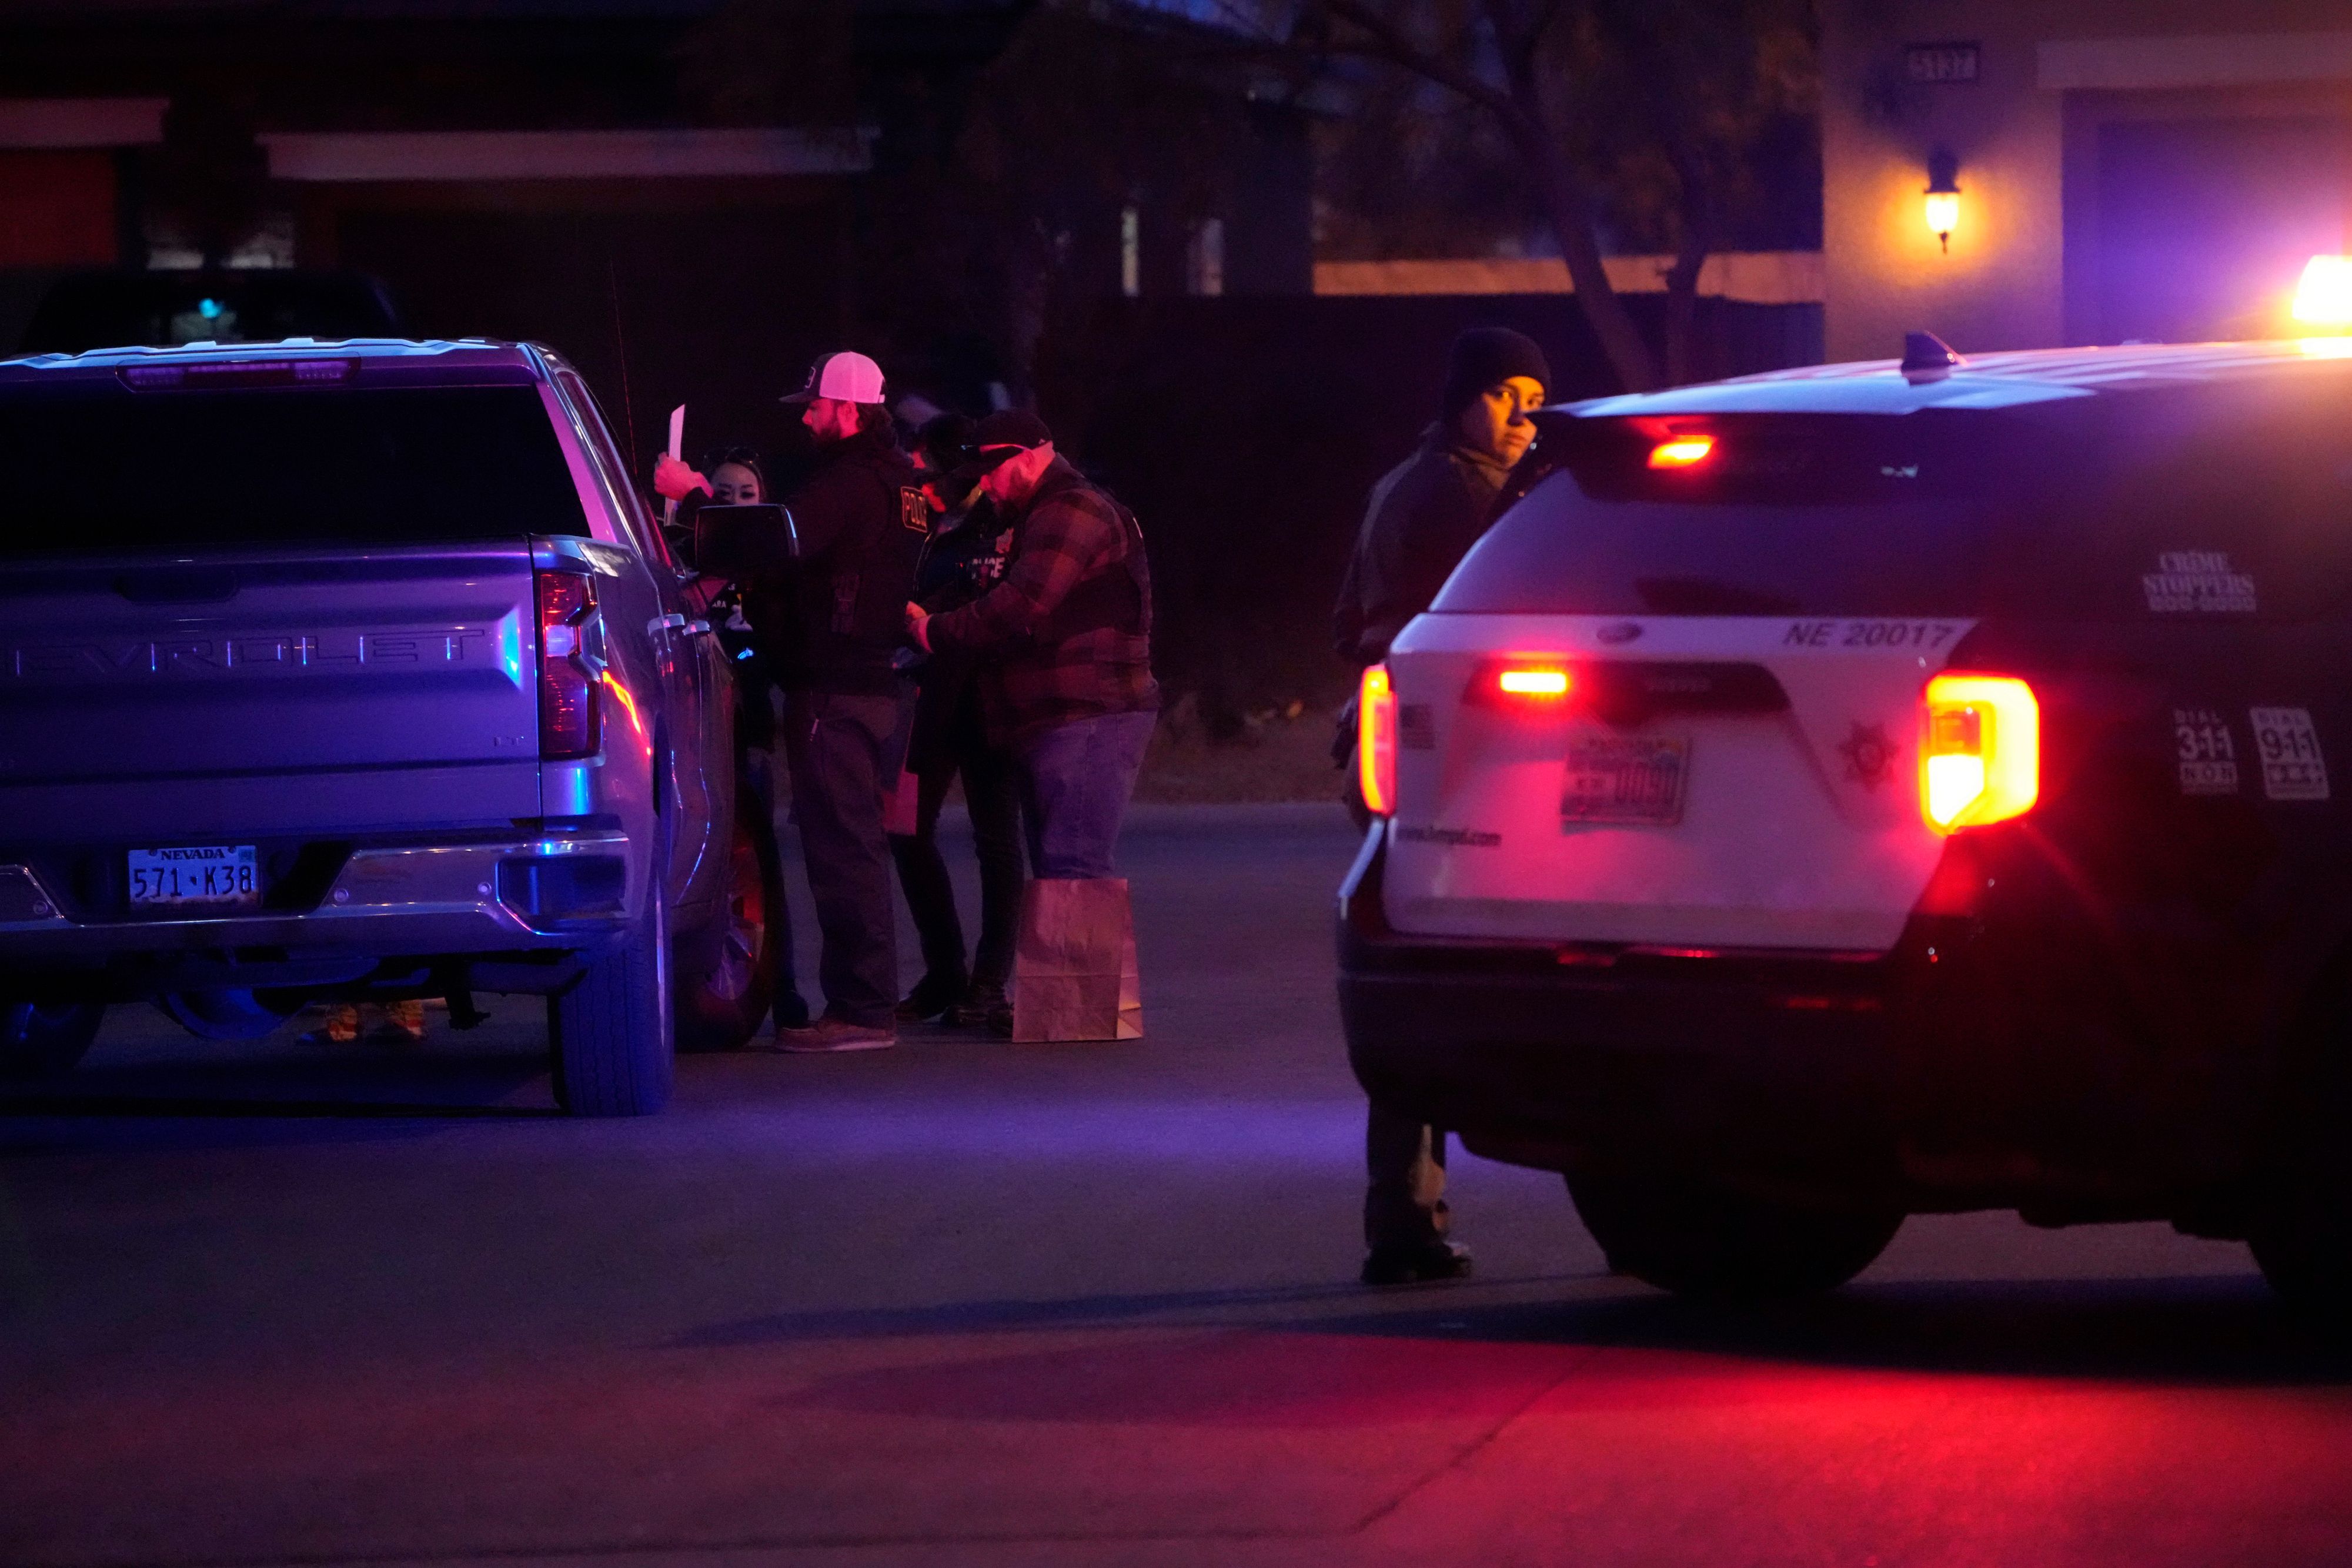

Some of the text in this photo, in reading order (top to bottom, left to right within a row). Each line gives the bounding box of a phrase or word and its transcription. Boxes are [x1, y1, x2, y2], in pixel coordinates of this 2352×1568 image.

[2159, 551, 2232, 571] CRIME
[2143, 574, 2256, 594] STOPPERS
[1782, 623, 1955, 648] NE 20017
[161, 848, 225, 860] NEVADA
